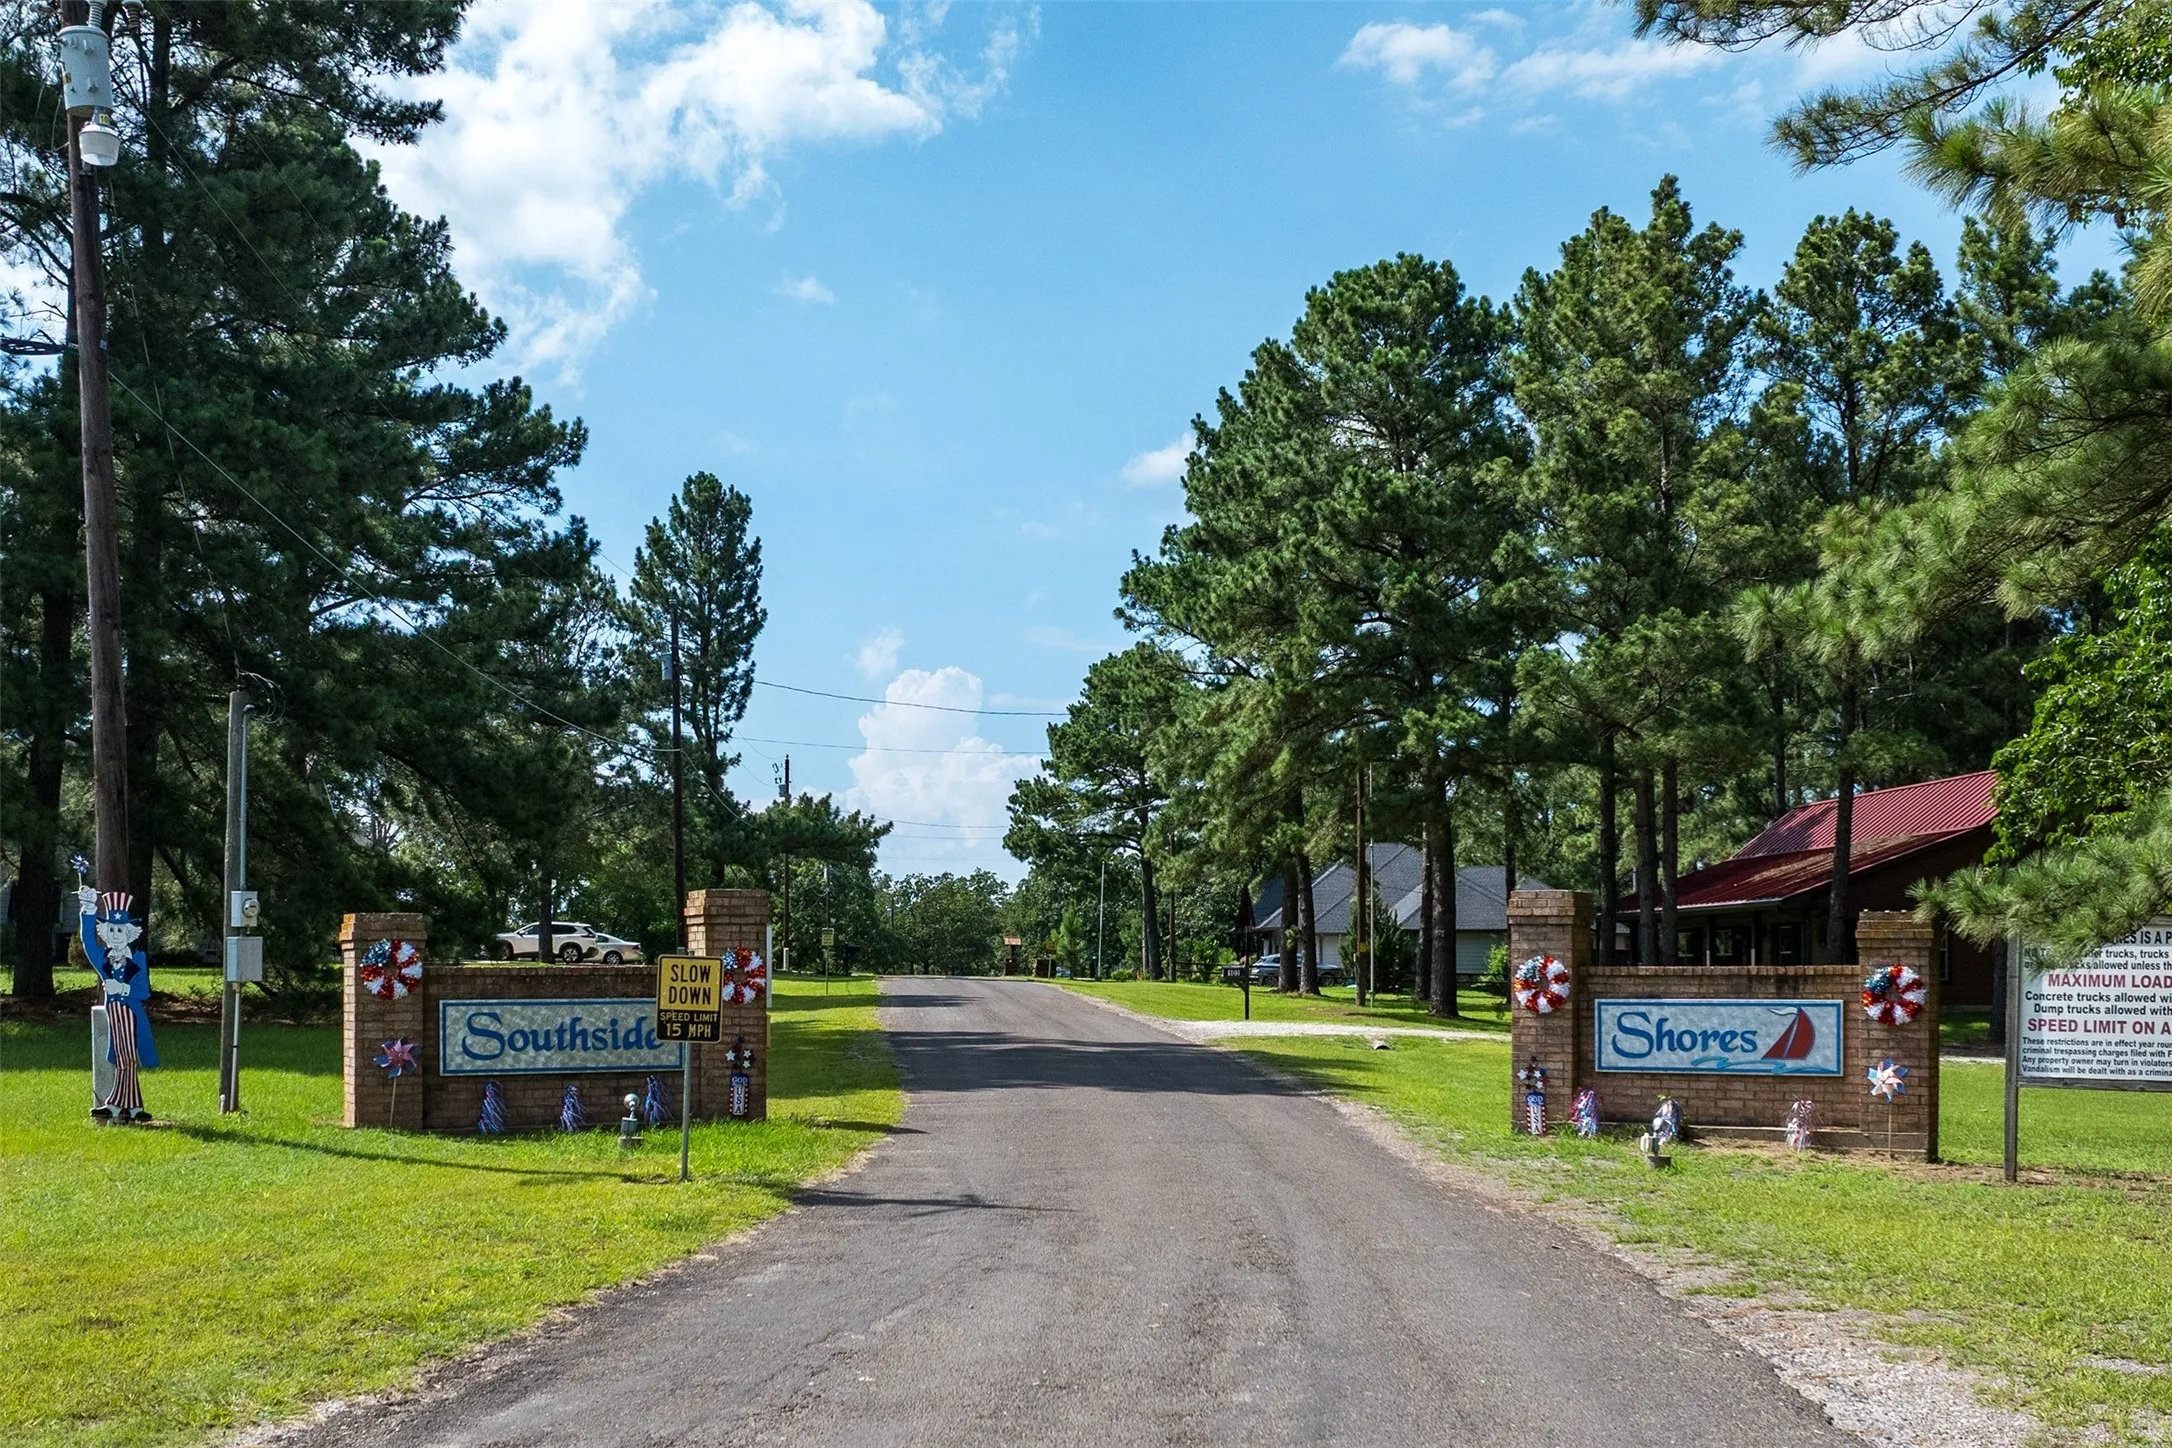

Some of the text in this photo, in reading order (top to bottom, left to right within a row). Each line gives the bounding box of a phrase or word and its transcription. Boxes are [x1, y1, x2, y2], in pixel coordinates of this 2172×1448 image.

[2140, 931, 2151, 944] IS
[2154, 931, 2162, 944] A
[2106, 949, 2137, 960] trucks,
[2140, 949, 2169, 958] trucks
[2093, 960, 2128, 969] allowed
[2131, 961, 2161, 970] unless
[670, 964, 711, 983] SLOW
[2048, 974, 2126, 988] MAXIMUM
[668, 986, 711, 1005] DOWN
[2025, 990, 2073, 1001] Concrete
[2077, 992, 2111, 1002] trucks
[2114, 992, 2156, 1003] allowed
[2034, 1003, 2172, 1016] Dump trucks allowed with
[660, 1011, 718, 1022] SPEED LIMIT
[666, 1023, 711, 1038] 15 MPH
[2028, 1018, 2078, 1032] SPEED
[2084, 1020, 2127, 1034] LIMIT
[2132, 1021, 2155, 1035] ON
[461, 1012, 664, 1061] Southside
[1611, 1012, 1758, 1059] Shores
[2023, 1036, 2045, 1045] These
[2046, 1038, 2089, 1046] restrictions
[2114, 1039, 2136, 1047] effect
[2138, 1041, 2155, 1049] year
[2022, 1046, 2052, 1054] criminal
[2054, 1048, 2096, 1057] trespassing
[2098, 1049, 2128, 1058] charges
[2130, 1049, 2147, 1057] filed
[2022, 1055, 2036, 1065] Any
[2038, 1057, 2069, 1066] property
[2096, 1059, 2111, 1067] may
[2022, 1064, 2060, 1073] Vandalism
[2077, 1066, 2086, 1074] be
